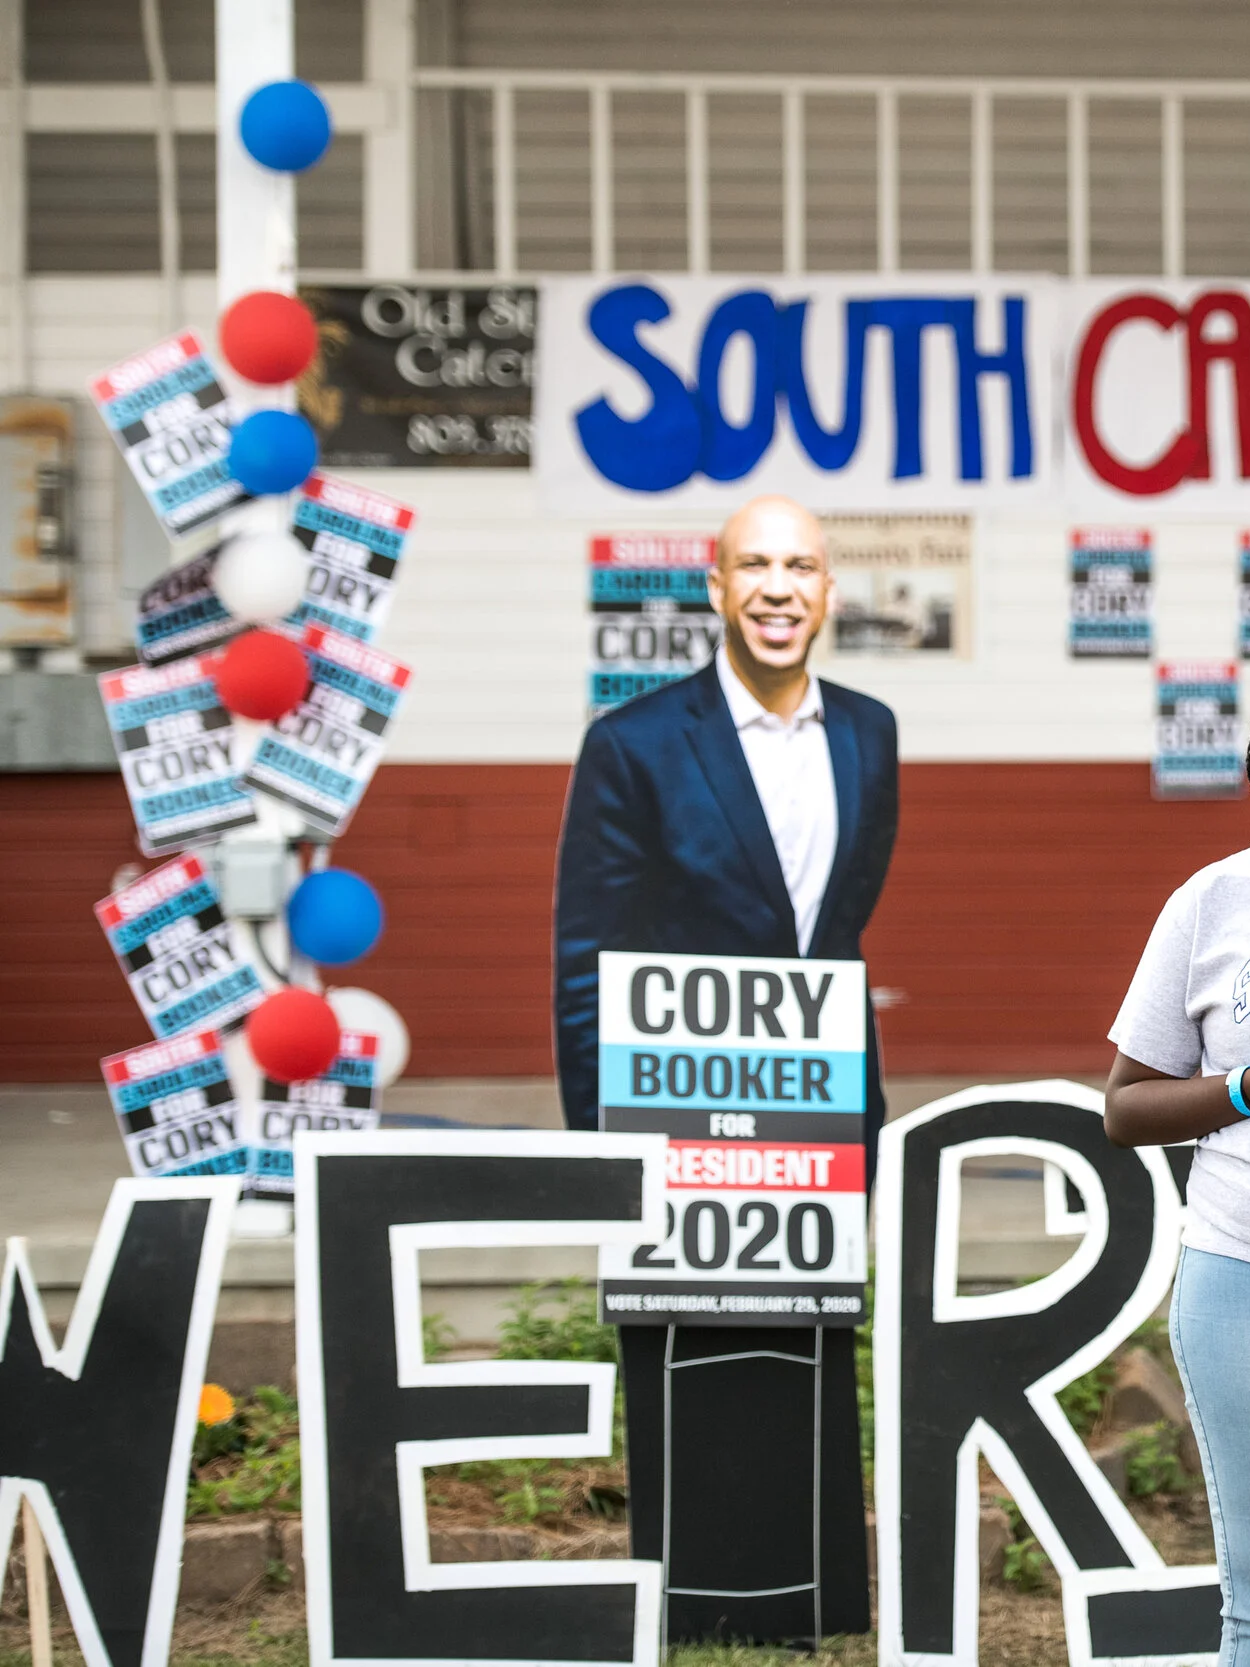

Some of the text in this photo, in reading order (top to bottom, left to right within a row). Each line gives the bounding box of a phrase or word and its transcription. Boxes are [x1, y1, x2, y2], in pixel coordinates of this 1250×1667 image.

[360, 285, 466, 338] Old
[573, 283, 1035, 493] SOUTH
[305, 566, 383, 612] ORY
[630, 964, 835, 1040] CORY
[630, 1052, 833, 1103] BOOKER
[138, 1110, 238, 1171] CORY
[709, 1112, 757, 1138] FOR
[664, 1146, 835, 1188] RESIDENT
